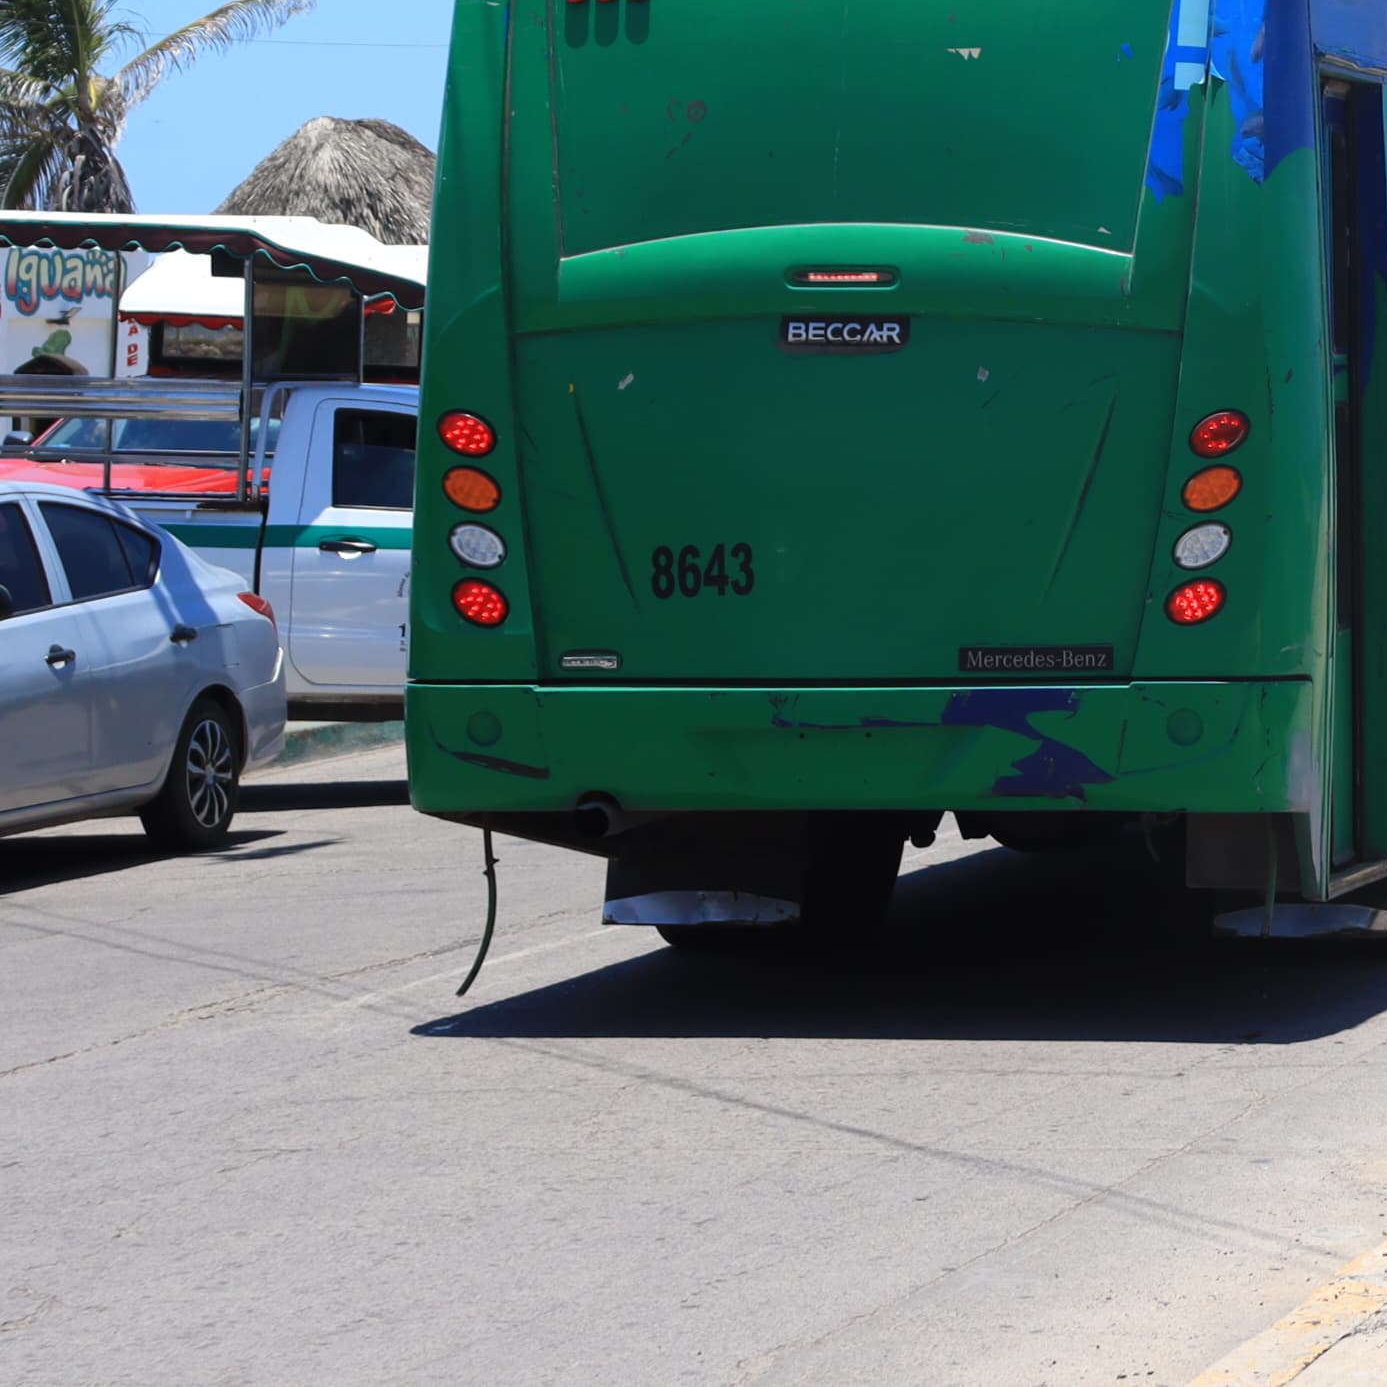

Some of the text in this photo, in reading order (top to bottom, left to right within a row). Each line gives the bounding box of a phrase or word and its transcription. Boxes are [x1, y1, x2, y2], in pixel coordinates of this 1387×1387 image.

[788, 322, 901, 343] BECCAR
[651, 541, 755, 599] 8643
[966, 650, 1107, 669] Mercedes-Benz
